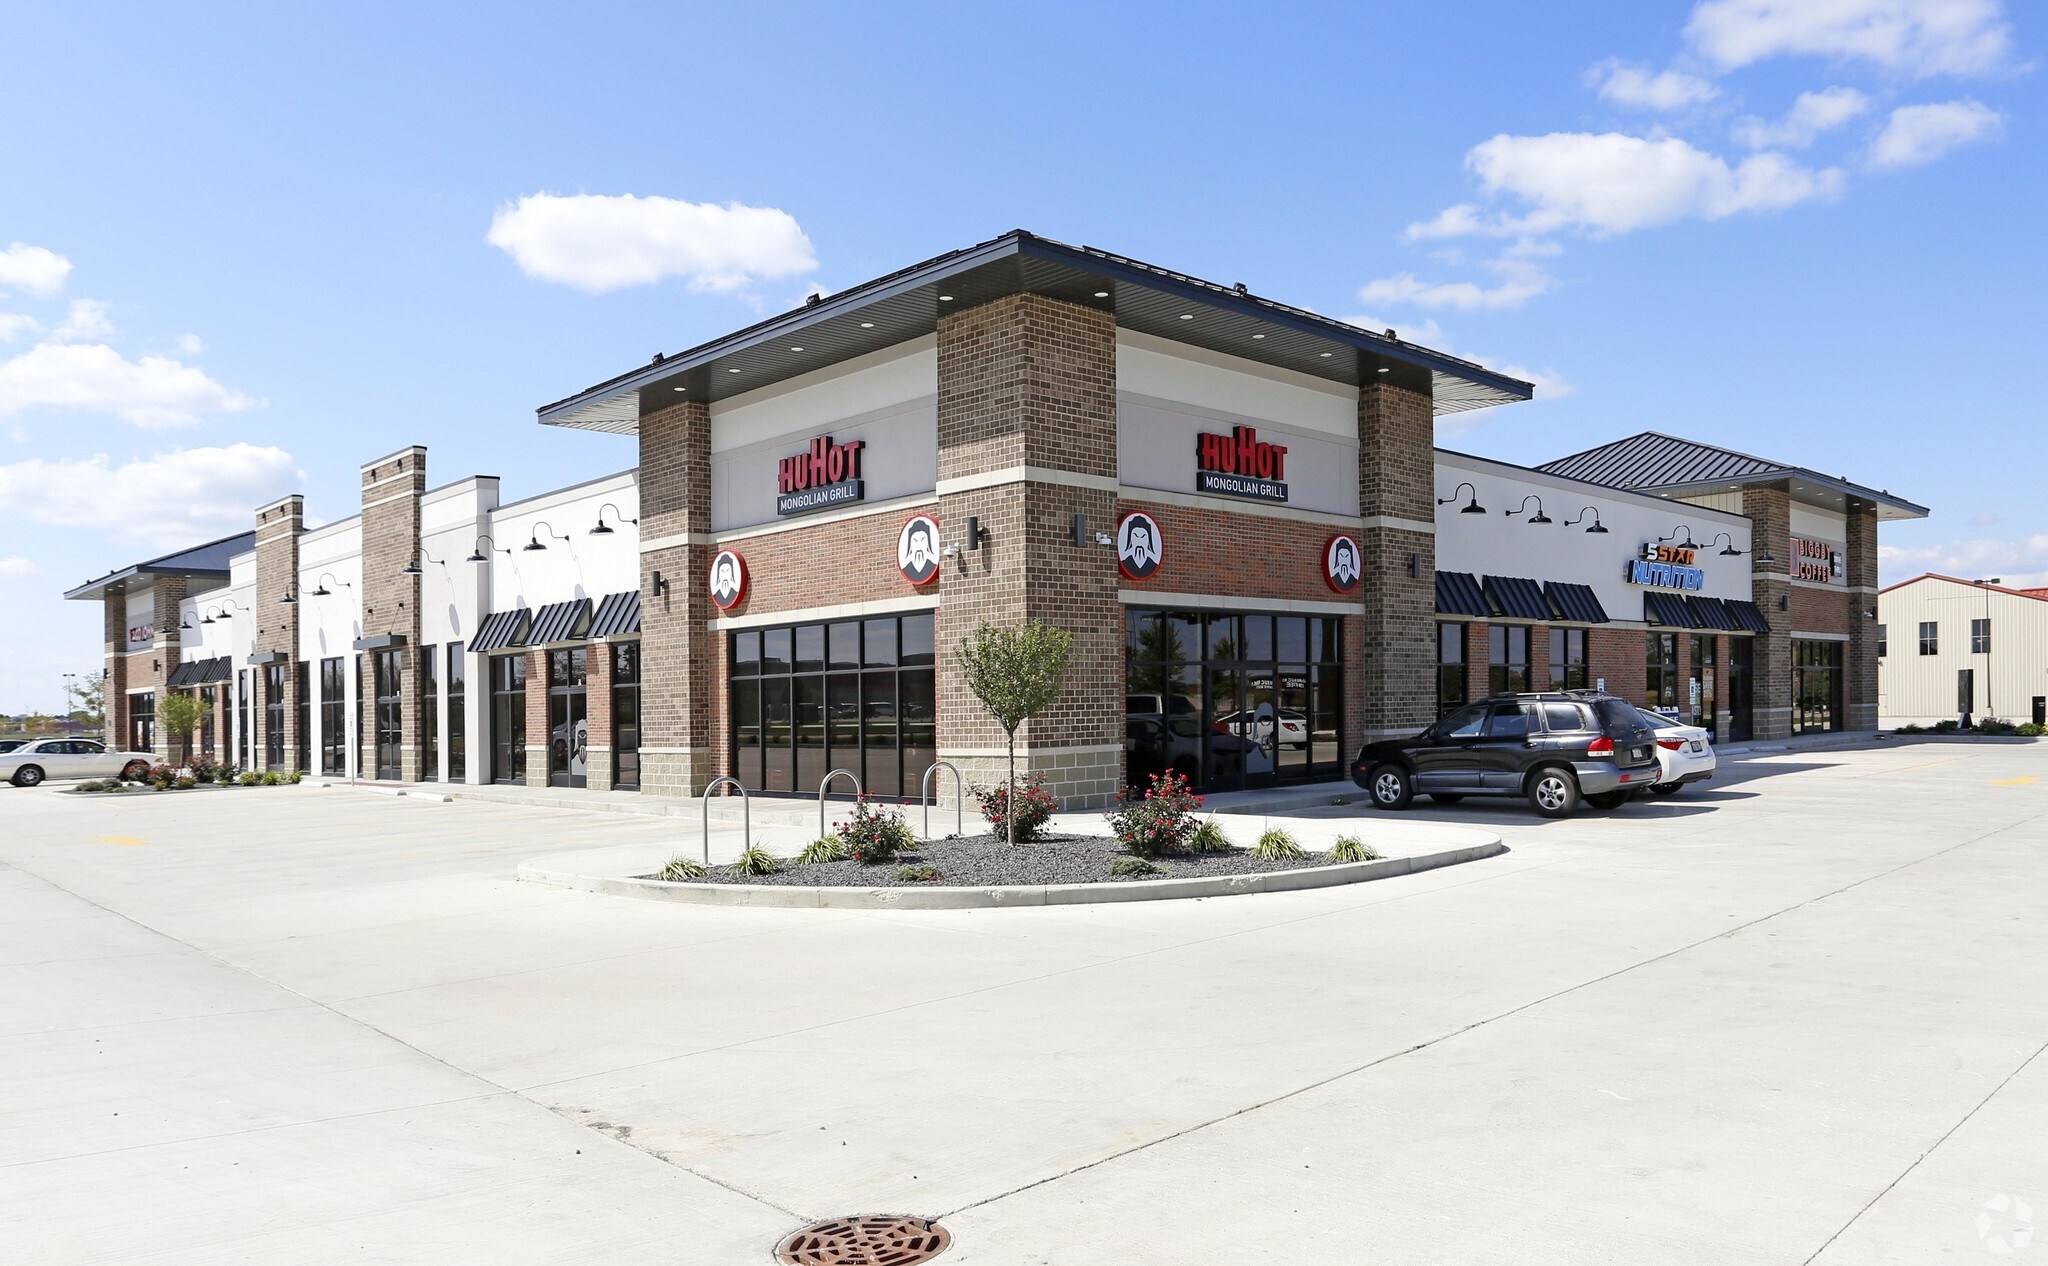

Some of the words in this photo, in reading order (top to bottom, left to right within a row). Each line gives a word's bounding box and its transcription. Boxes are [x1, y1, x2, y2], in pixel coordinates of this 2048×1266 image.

[780, 490, 828, 511] MONGOLIAN
[829, 485, 855, 501] GRILL
[1206, 476, 1258, 494] MONGOLIAN
[1260, 484, 1284, 498] GRILL
[1799, 539, 1831, 560] BIGGBY
[1631, 560, 1704, 590] NUTRITION
[1799, 562, 1831, 582] COFFEE
